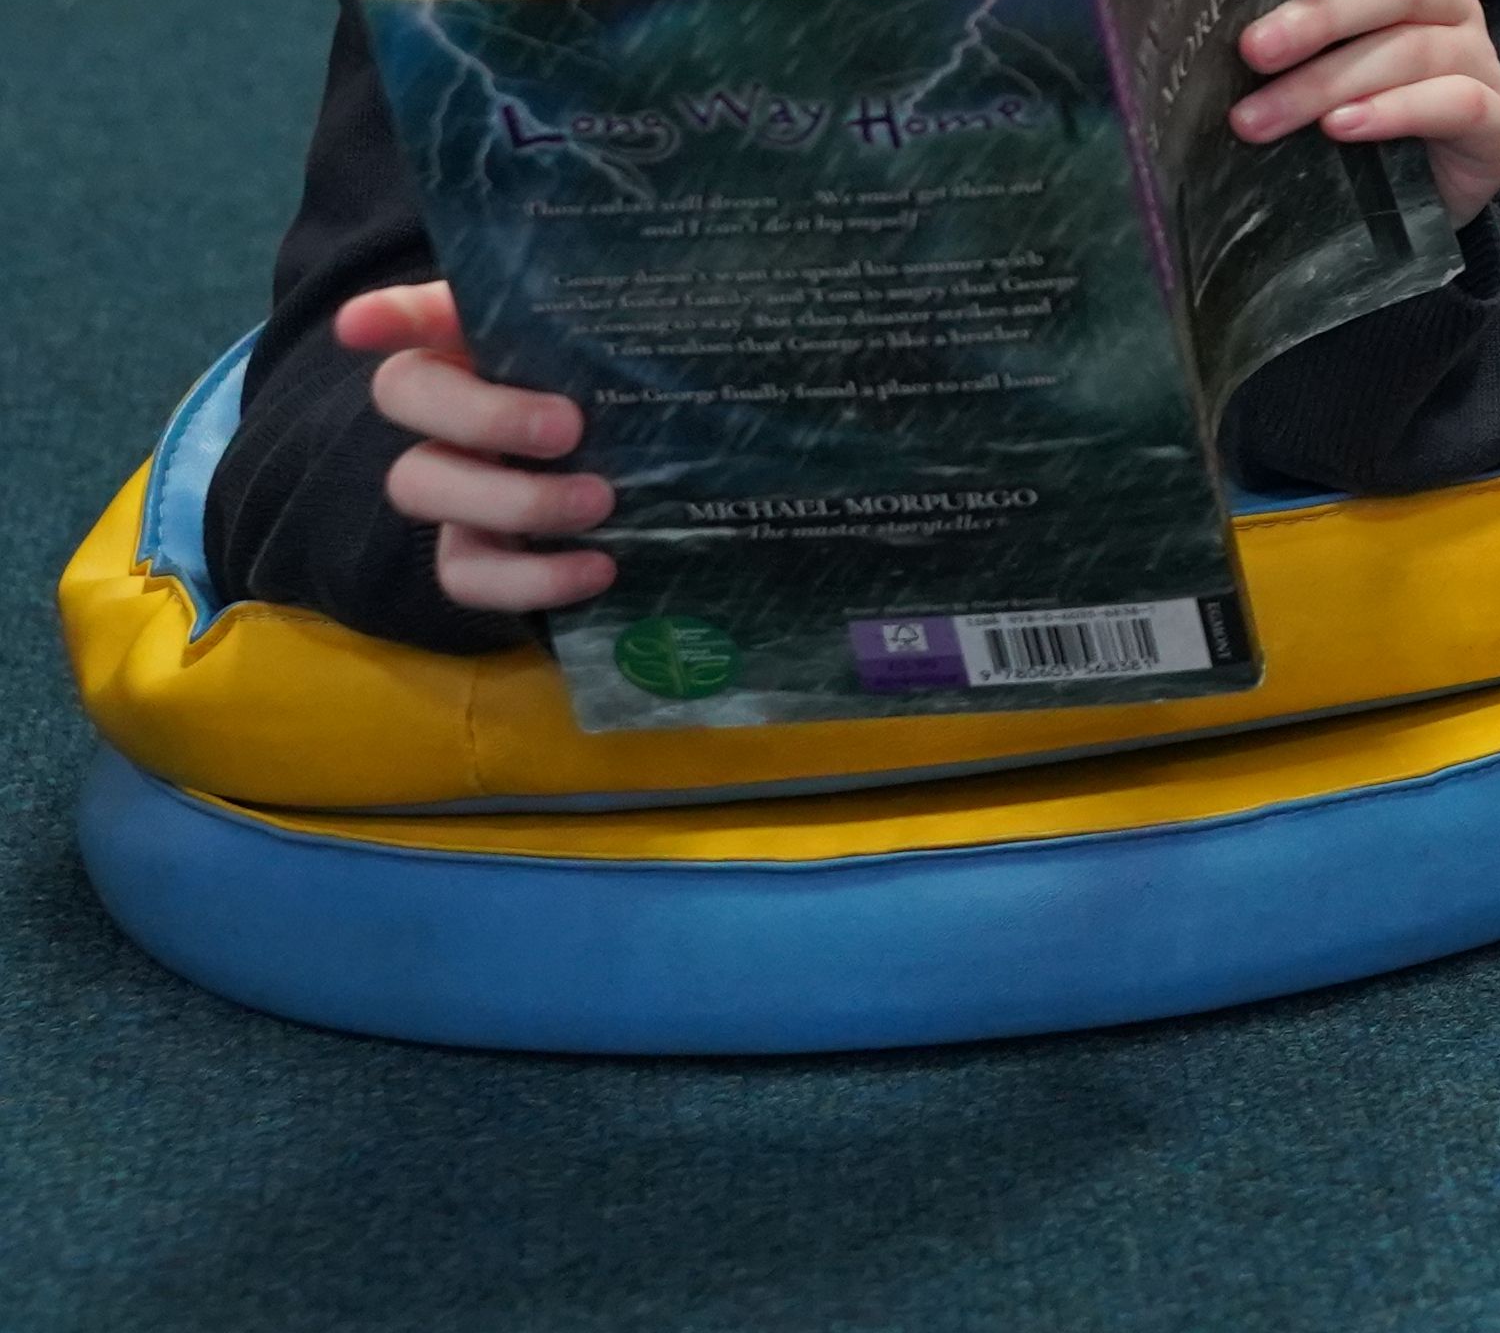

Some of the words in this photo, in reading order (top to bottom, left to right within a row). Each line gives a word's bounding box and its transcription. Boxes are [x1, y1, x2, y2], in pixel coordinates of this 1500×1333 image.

[502, 99, 682, 165] Long
[672, 85, 834, 153] Way
[845, 93, 1037, 151] Home
[686, 499, 842, 522] MICHAEL
[844, 487, 1039, 517] MORPURGO
[749, 521, 785, 540] The
[792, 522, 869, 539] master
